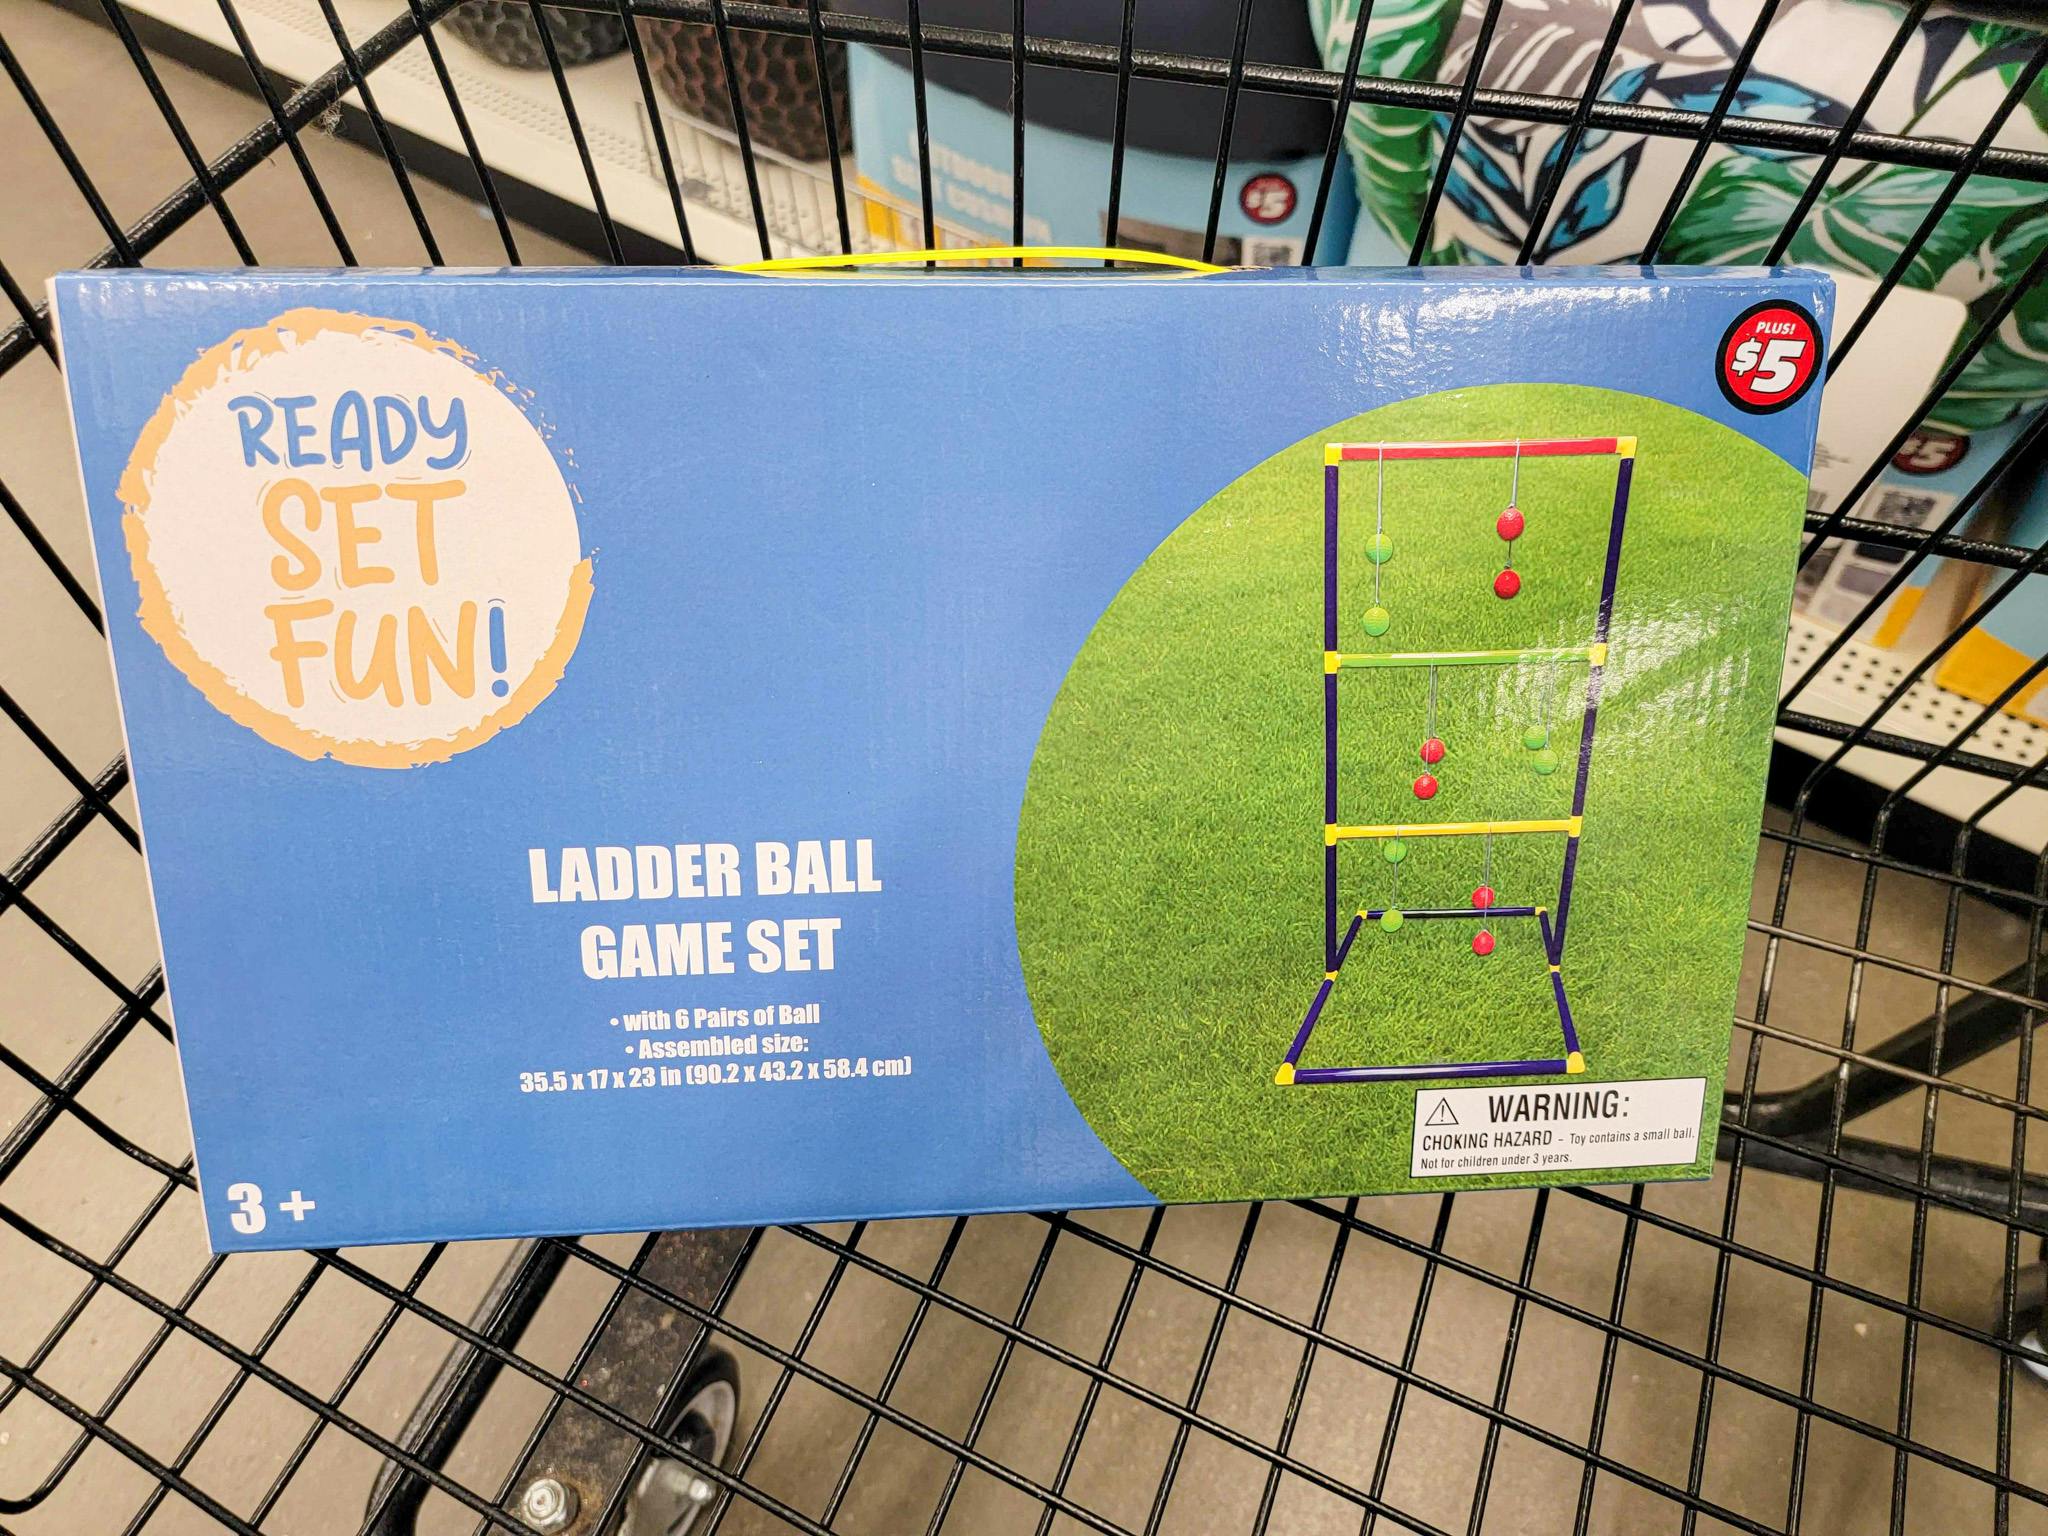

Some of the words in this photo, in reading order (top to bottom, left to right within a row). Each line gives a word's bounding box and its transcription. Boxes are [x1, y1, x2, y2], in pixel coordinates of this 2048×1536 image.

[1756, 320, 1795, 335] PLUS!
[1731, 337, 1807, 394] $5
[228, 390, 469, 472] READY
[262, 478, 467, 591] SET
[264, 598, 510, 708] FUN!
[528, 843, 741, 903] LADDER
[755, 839, 882, 895] BALL
[580, 921, 735, 980] GAME
[746, 917, 842, 973] SET
[623, 1011, 671, 1031] with
[675, 1010, 690, 1029] 6
[694, 1008, 749, 1028] Pairs
[753, 1006, 775, 1025] of
[779, 1004, 820, 1024] Ball
[639, 1034, 757, 1059] Assembled
[762, 1033, 809, 1053] size:
[520, 1070, 568, 1093] 35.5
[572, 1074, 584, 1090] x
[587, 1070, 608, 1089] 17
[612, 1072, 625, 1088] x
[629, 1067, 656, 1087] 23
[660, 1065, 681, 1085] in
[685, 1063, 739, 1085] (90.2
[743, 1067, 755, 1082] x
[759, 1061, 803, 1081] 43.2
[807, 1063, 819, 1079] x
[823, 1058, 868, 1079] 58.4
[872, 1056, 912, 1077] cm)
[1488, 1090, 1630, 1123] WARNING:
[1422, 1132, 1489, 1151] CHOKING
[1493, 1130, 1552, 1148] HAZARD
[1569, 1132, 1586, 1146] Toy
[1589, 1129, 1630, 1144] contains
[1634, 1133, 1640, 1142] a
[1642, 1128, 1671, 1141] small
[1673, 1127, 1695, 1139] ball.
[1421, 1156, 1437, 1170] Not
[1441, 1156, 1454, 1168] for
[1457, 1154, 1499, 1168] children
[1501, 1154, 1529, 1166] under
[1533, 1154, 1539, 1164] 3
[1542, 1153, 1572, 1167] years.
